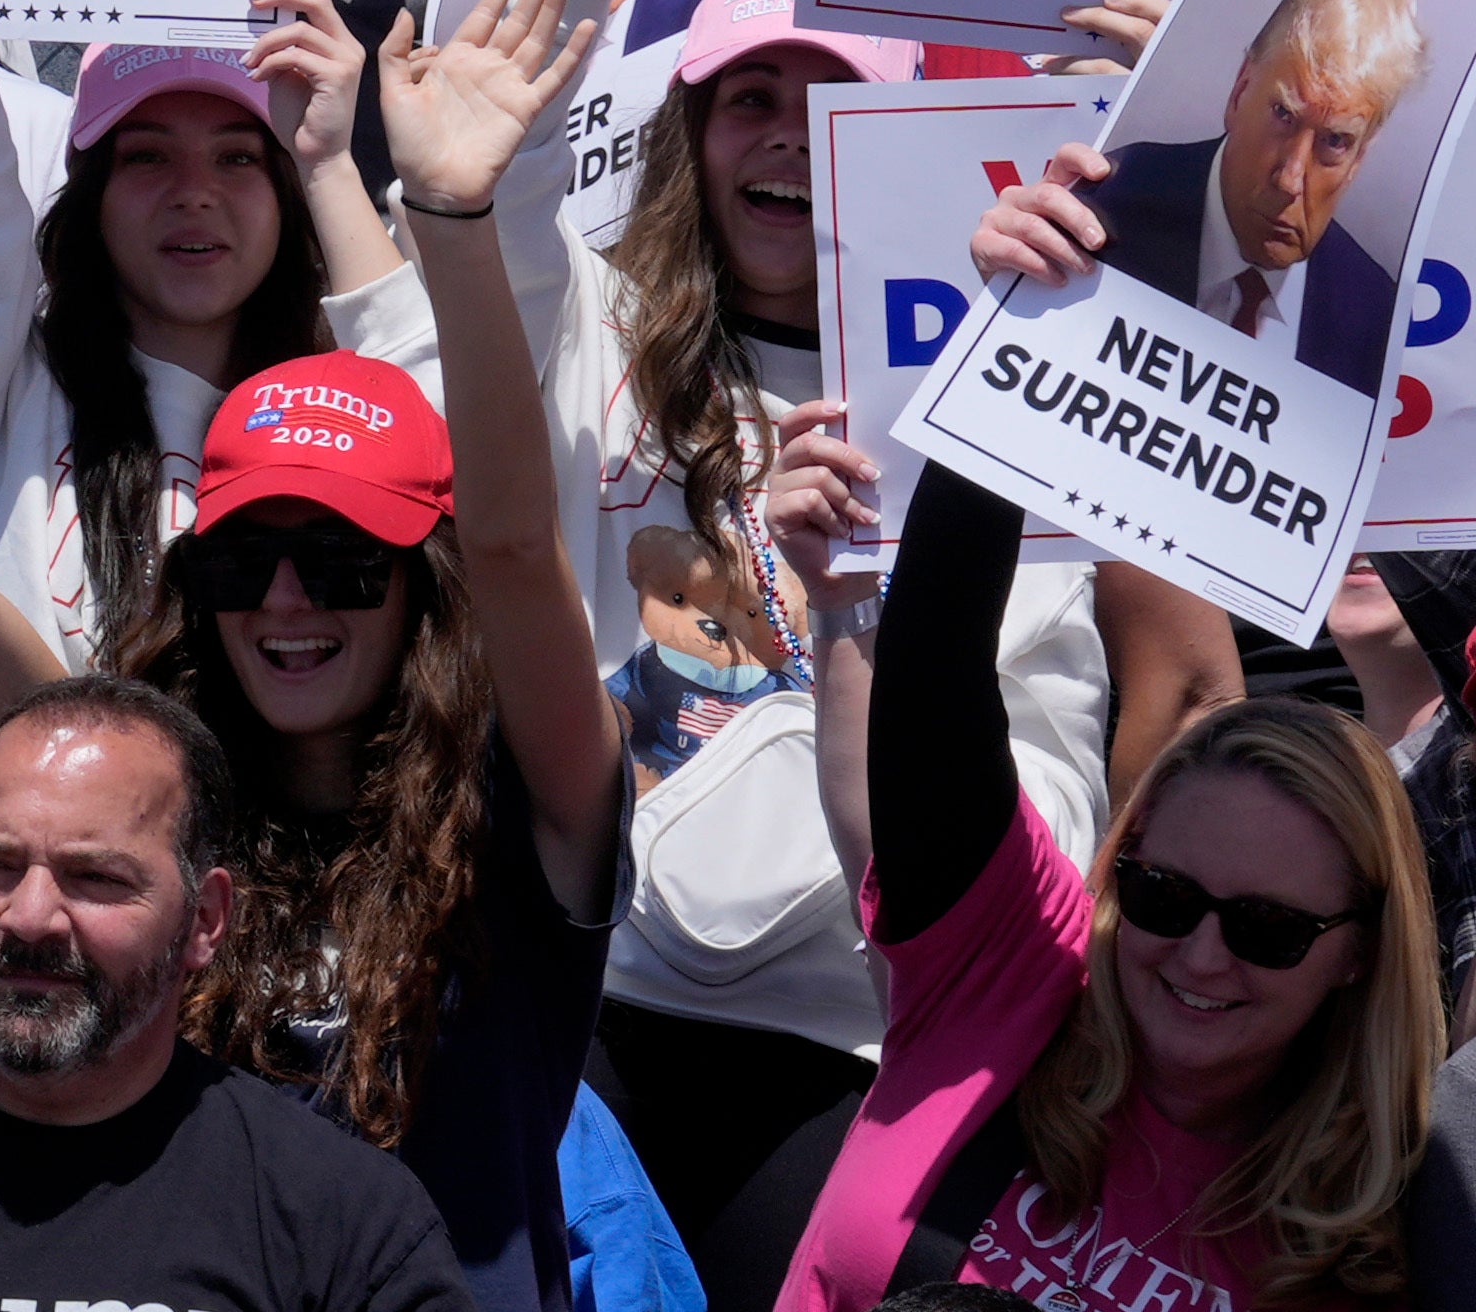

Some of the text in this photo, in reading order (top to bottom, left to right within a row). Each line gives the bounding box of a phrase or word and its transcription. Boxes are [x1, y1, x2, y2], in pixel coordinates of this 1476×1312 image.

[113, 46, 252, 81] GREAT AGA
[1097, 316, 1281, 444] NEVER
[252, 383, 395, 433] Trump
[269, 425, 355, 453] 2020
[982, 344, 1329, 546] SURRENDER
